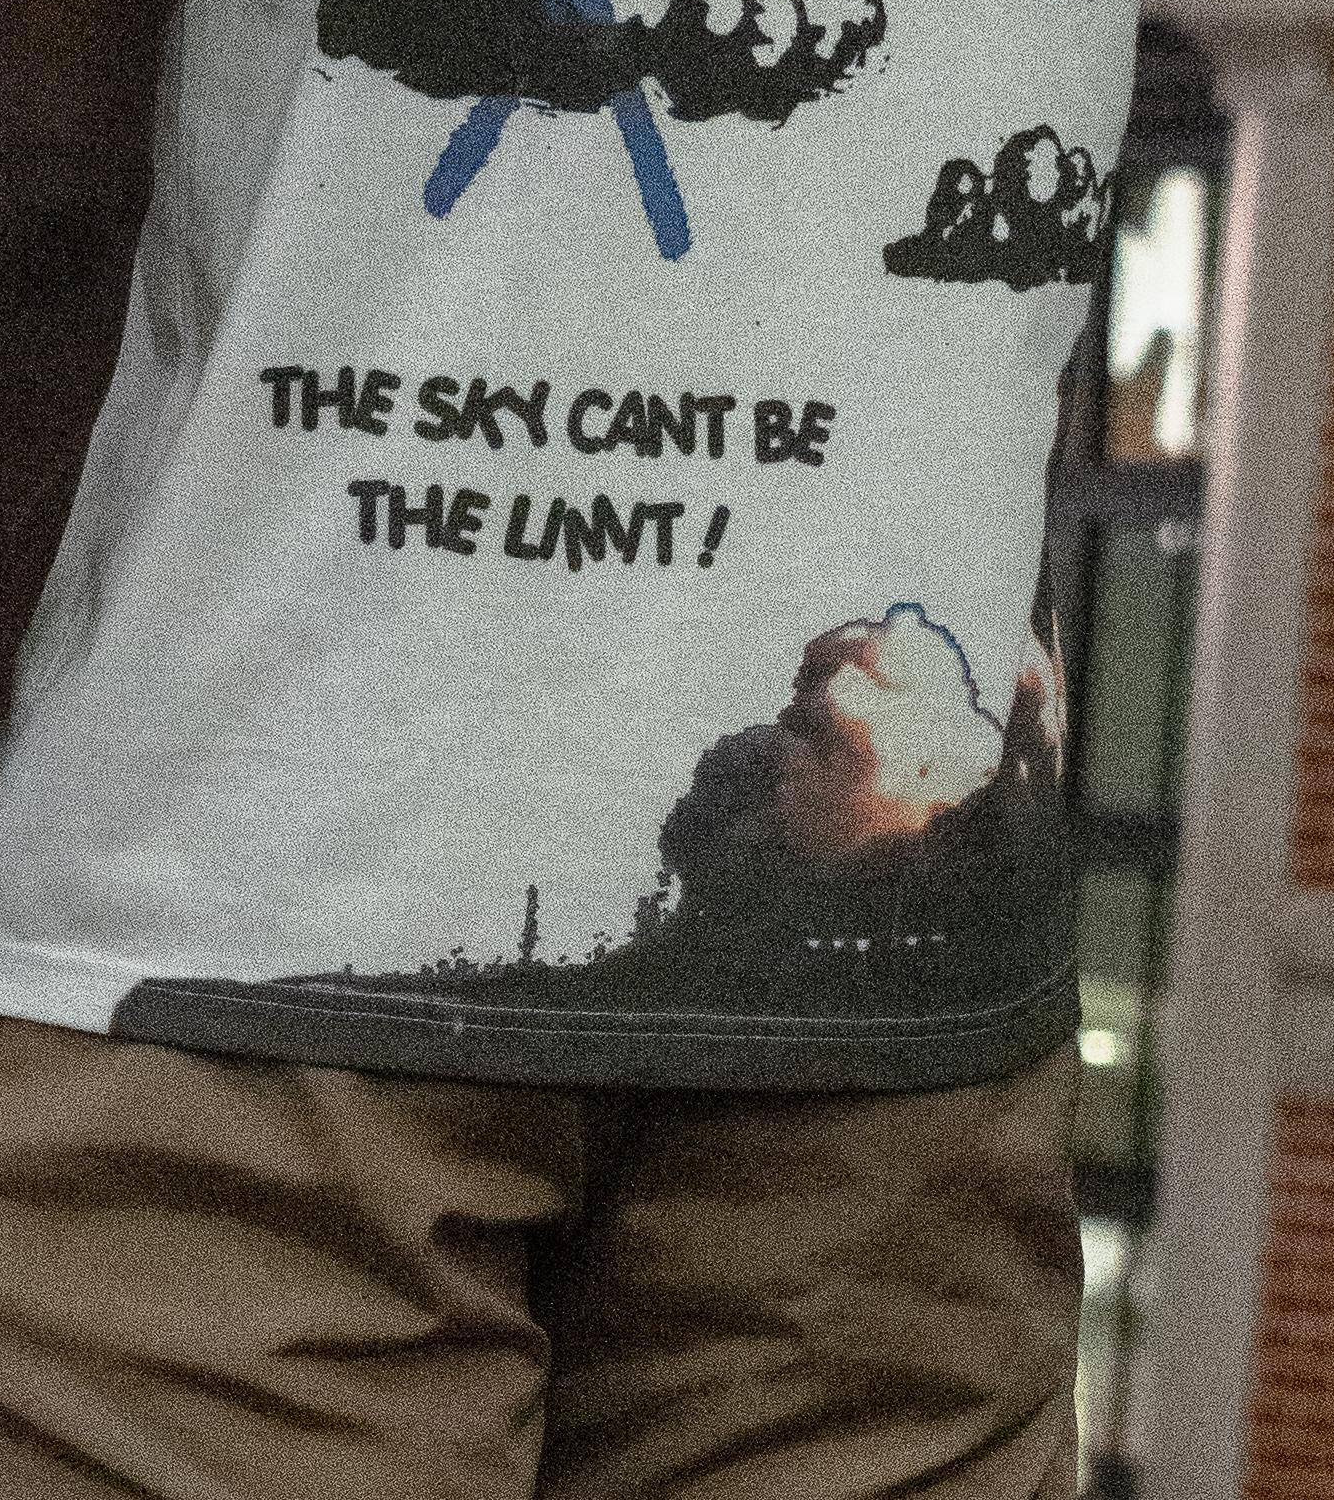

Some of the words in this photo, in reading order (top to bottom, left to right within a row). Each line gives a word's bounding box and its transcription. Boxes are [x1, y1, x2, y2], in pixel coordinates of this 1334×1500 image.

[258, 364, 402, 437] THE
[413, 375, 552, 450] SKY
[565, 387, 737, 460] CANT
[753, 398, 837, 468] BE
[346, 478, 492, 556] THE
